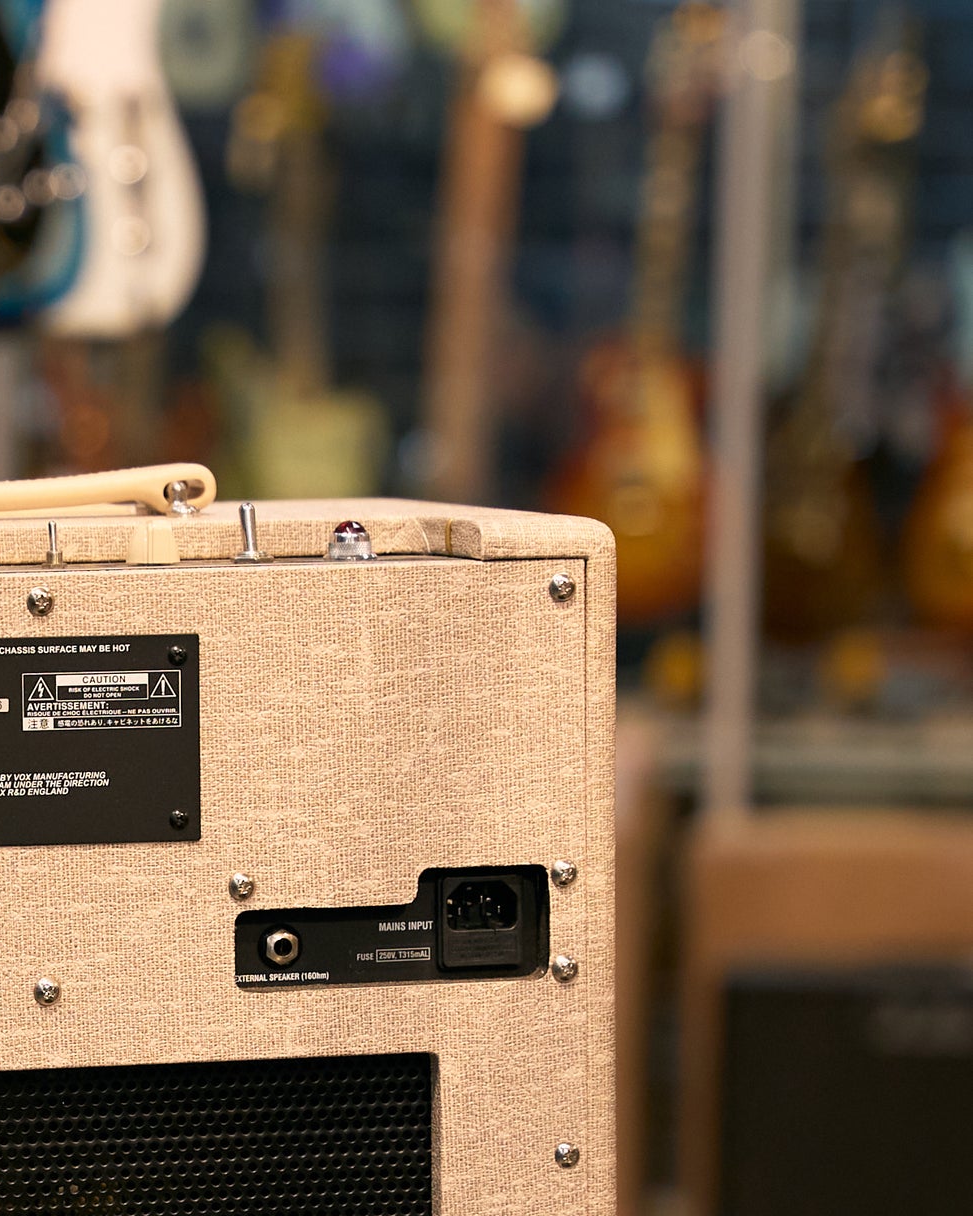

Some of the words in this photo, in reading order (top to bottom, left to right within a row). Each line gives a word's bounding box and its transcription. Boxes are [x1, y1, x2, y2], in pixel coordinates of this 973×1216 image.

[38, 645, 77, 654] SURFACE
[79, 644, 97, 653] MAY
[99, 644, 111, 652] BE
[112, 643, 130, 652] HOT
[82, 675, 126, 684] CAUTION
[27, 701, 109, 711] AVERTISSEMENT:
[28, 718, 50, 730] 注意
[0, 773, 12, 782] BY
[13, 773, 32, 781] VOX
[32, 771, 106, 781] MANUFACTURING
[13, 780, 43, 789] UNDER
[45, 779, 62, 788] THE
[63, 778, 110, 788] DIRECTION
[7, 788, 26, 797] R&D
[27, 787, 69, 796] ENGLAND
[378, 921, 406, 932] MAINS
[408, 920, 434, 931] INPUT
[356, 952, 374, 961] FUSE
[398, 950, 429, 959] T315mAL
[269, 972, 300, 982] SPEAKER
[301, 971, 330, 982] (16Ohm)
